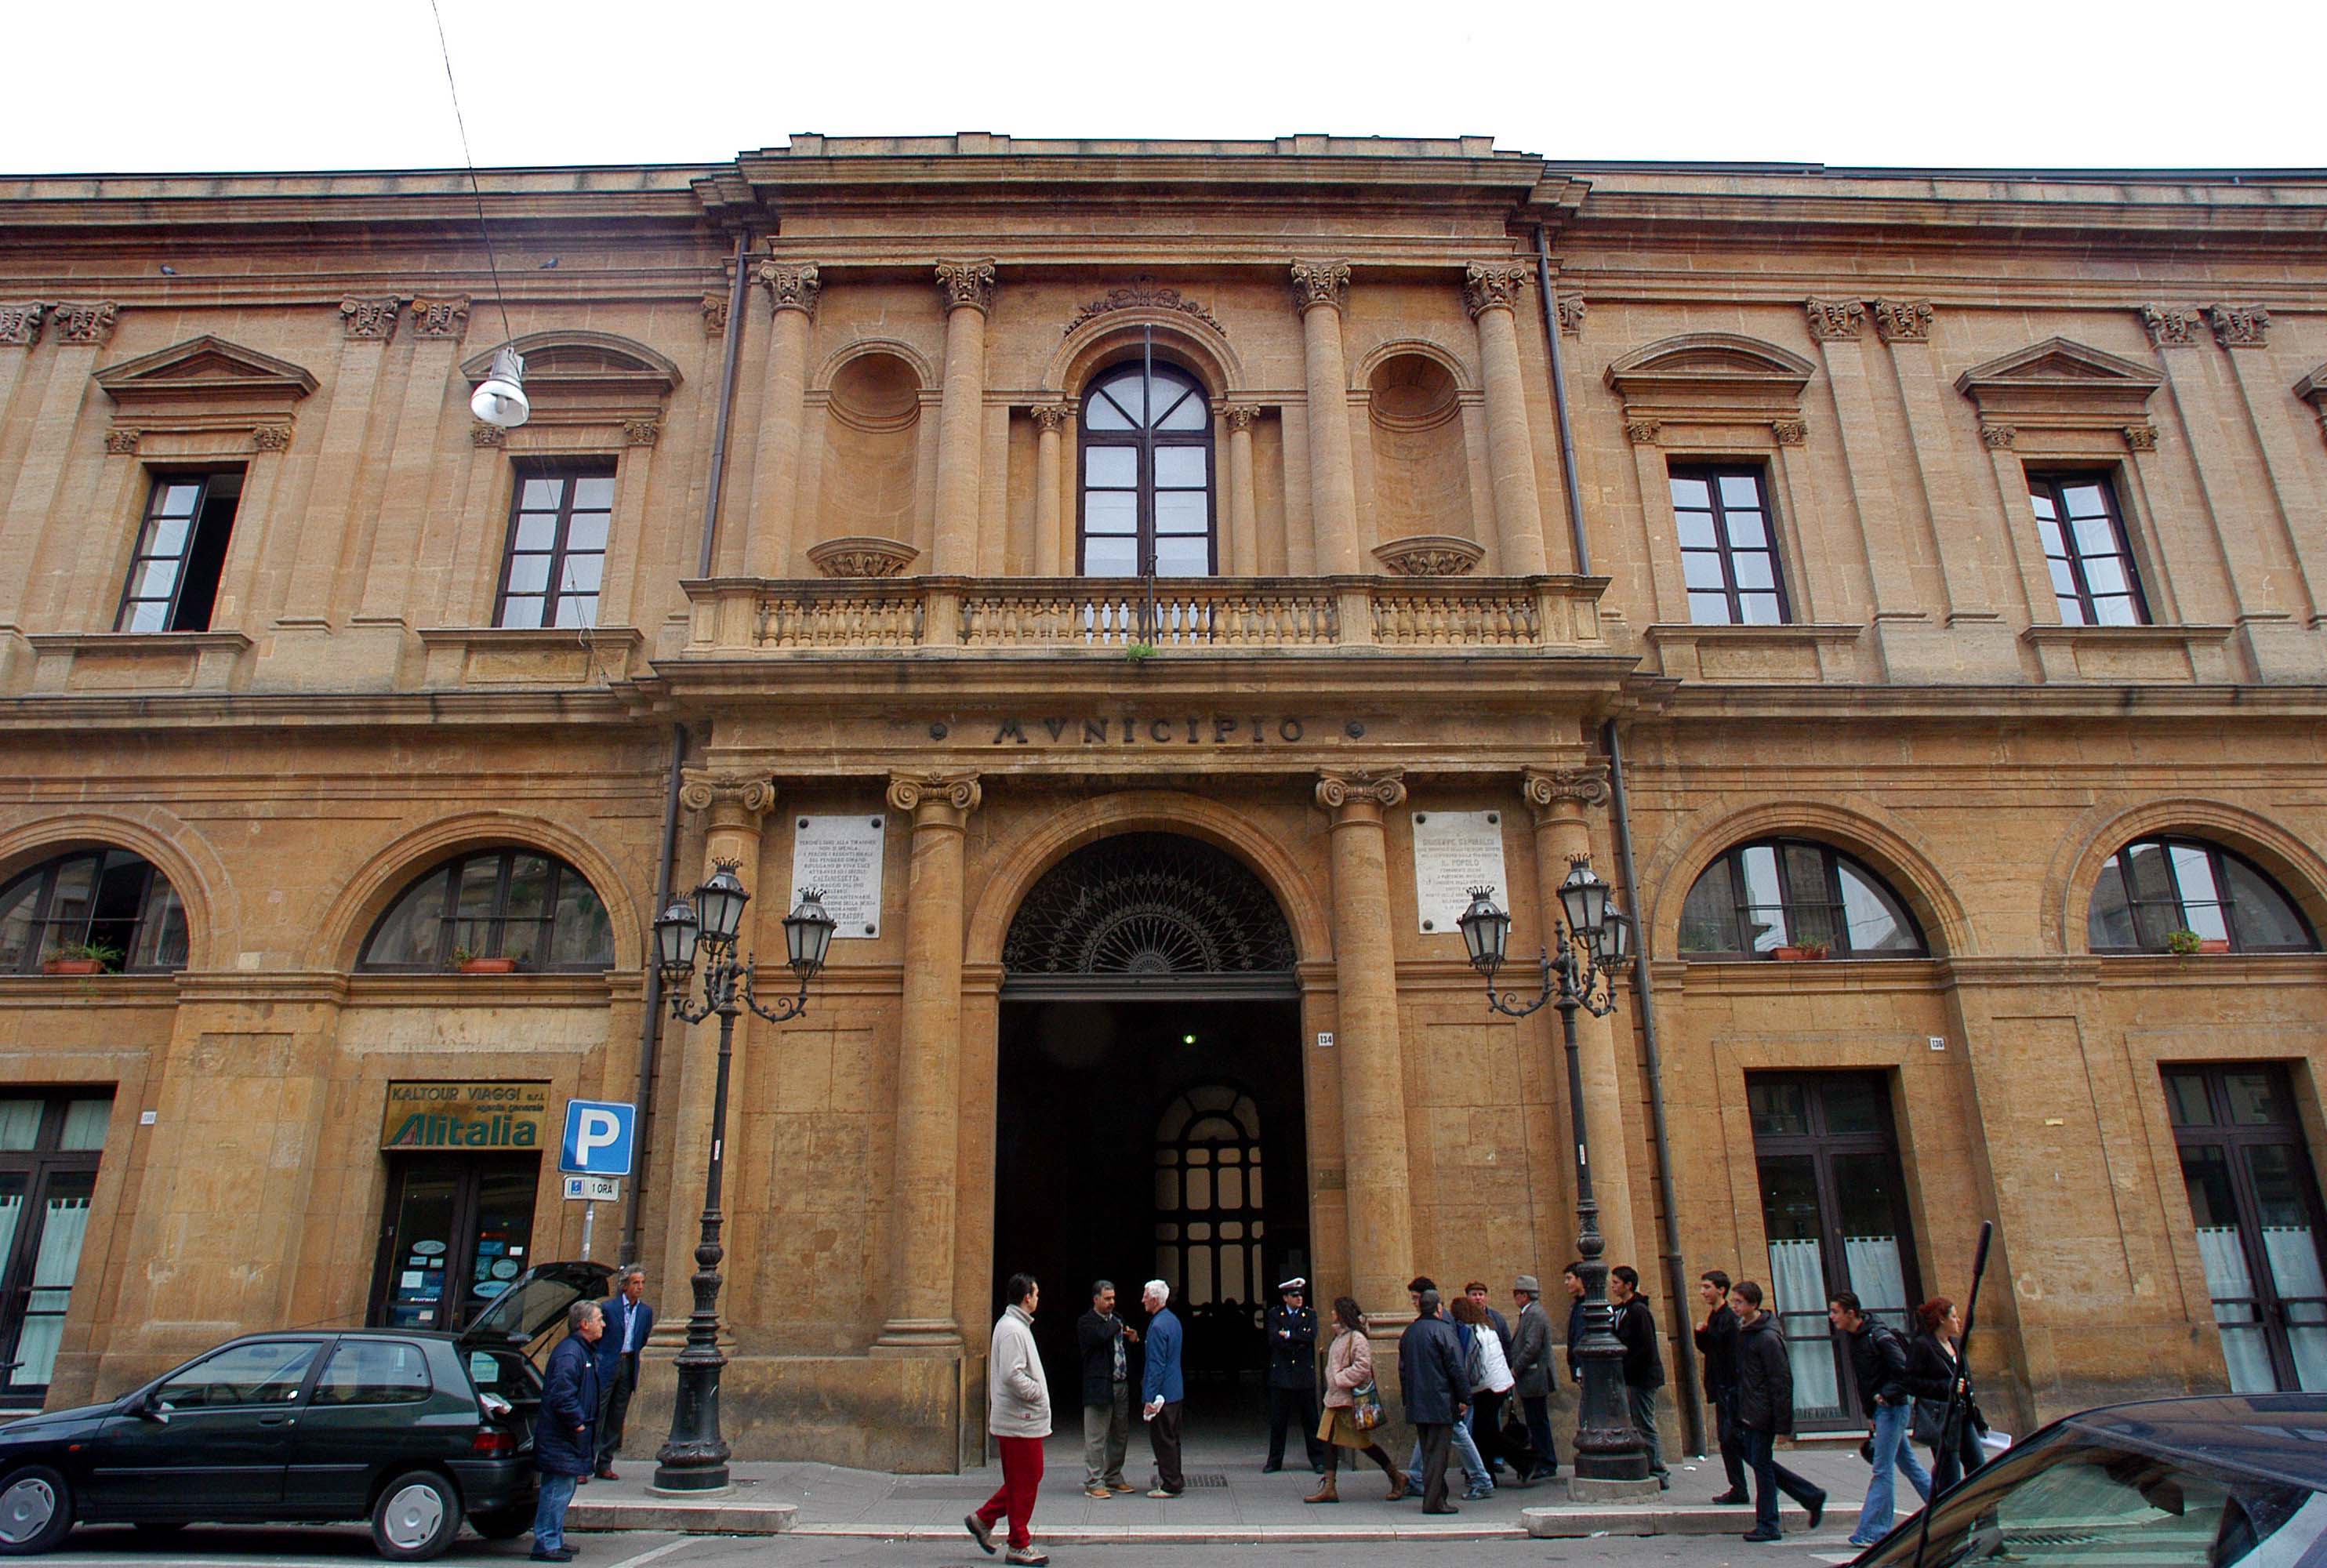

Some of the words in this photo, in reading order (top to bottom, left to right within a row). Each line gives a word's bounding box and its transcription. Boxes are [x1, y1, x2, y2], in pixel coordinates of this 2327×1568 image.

[993, 717, 1304, 743] MVNICIPIO
[1320, 1035, 1332, 1044] 134
[392, 1087, 459, 1101] KALTOUR
[467, 1087, 521, 1101] VIAGGI
[388, 1112, 537, 1146] Alitalia
[575, 1108, 620, 1166] P
[597, 1184, 612, 1193] ORA
